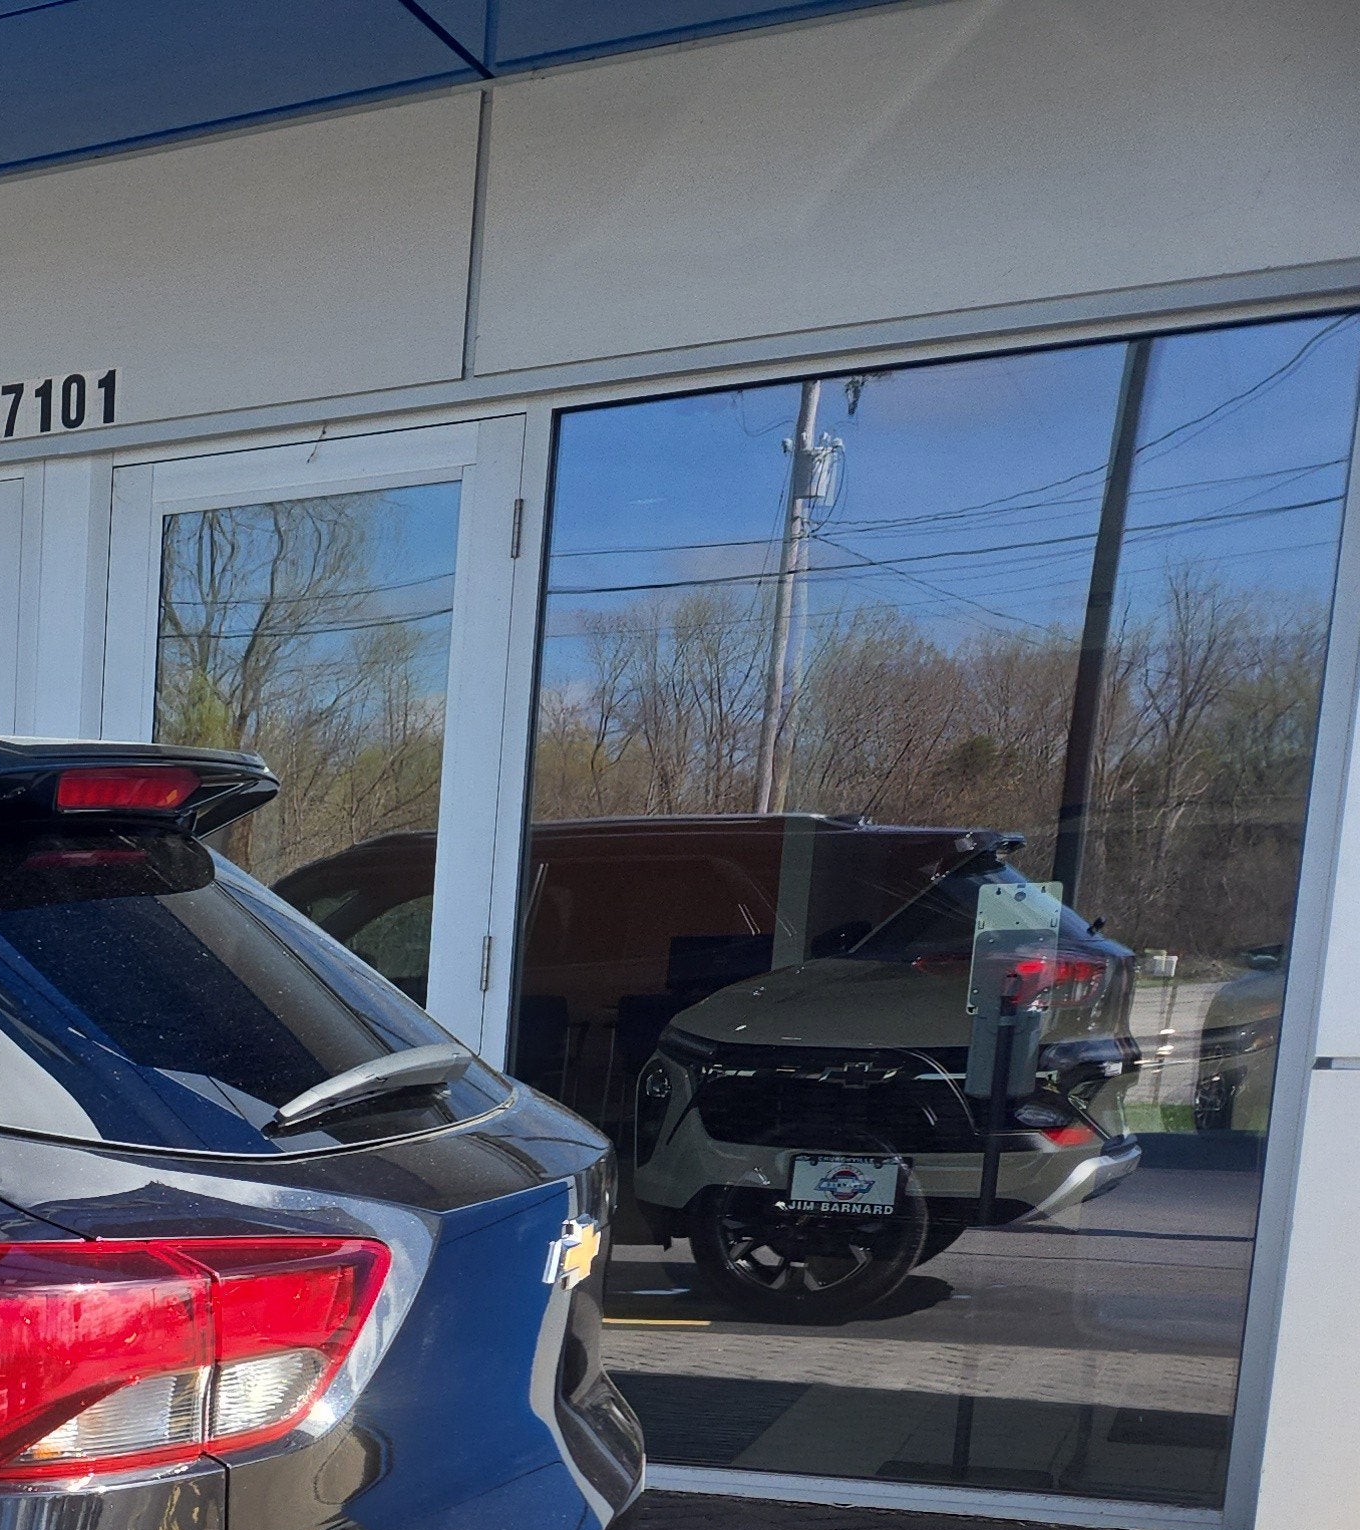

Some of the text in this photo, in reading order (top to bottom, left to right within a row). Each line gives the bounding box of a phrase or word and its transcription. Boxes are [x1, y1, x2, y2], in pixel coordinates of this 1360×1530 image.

[1, 369, 117, 438] 7101
[788, 1199, 894, 1216] JIM BARNARD
